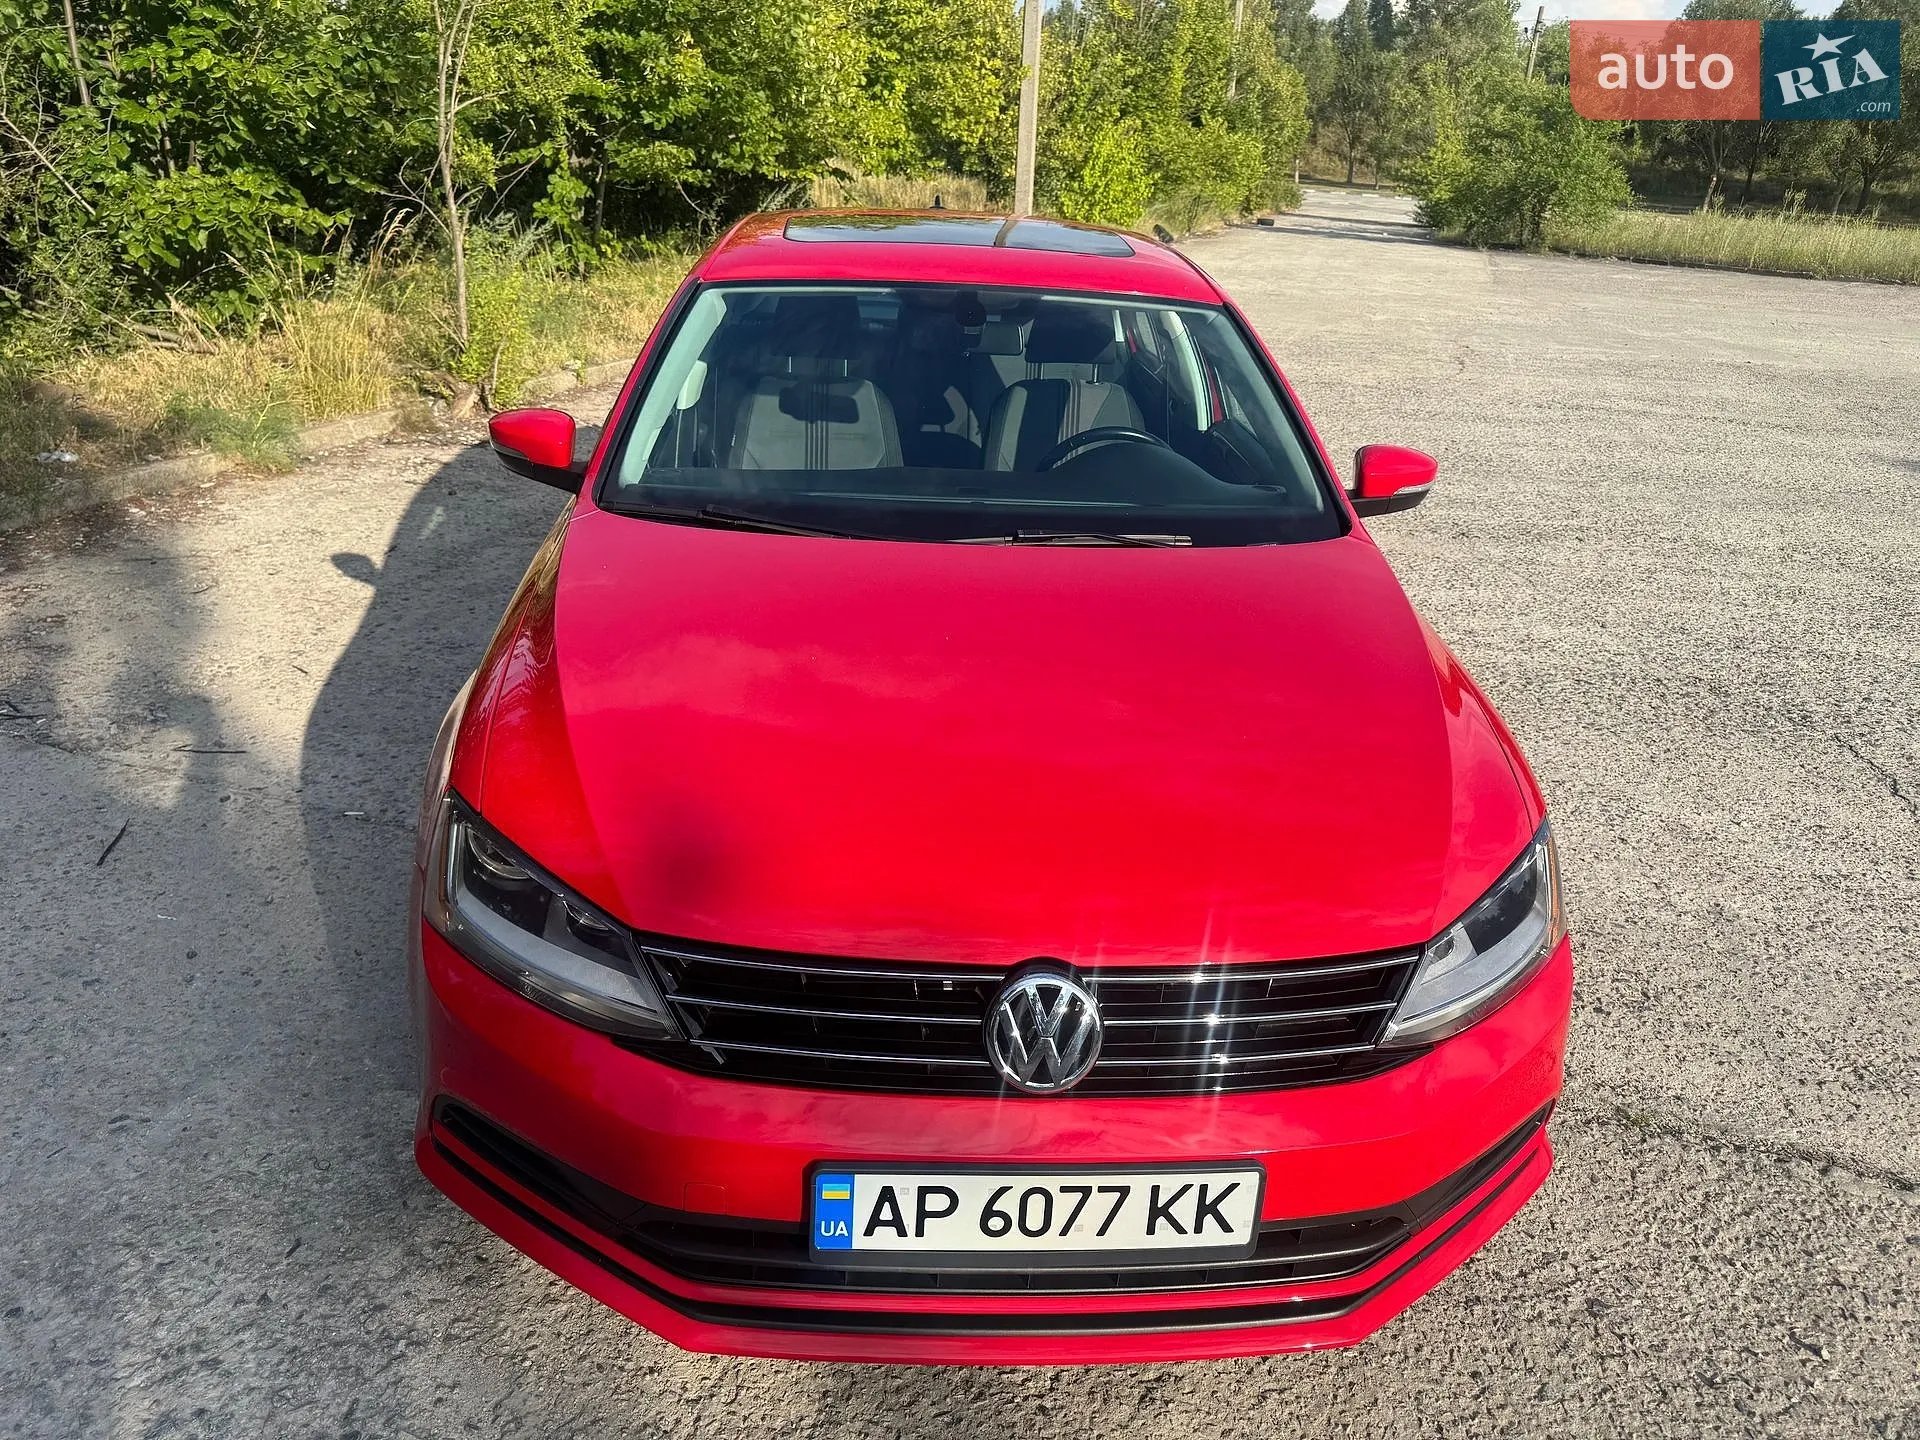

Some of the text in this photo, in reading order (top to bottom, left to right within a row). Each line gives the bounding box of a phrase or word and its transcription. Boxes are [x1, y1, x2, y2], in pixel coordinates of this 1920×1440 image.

[863, 1182, 1241, 1238] AP 6077 KK
[821, 1222, 849, 1237] UA
